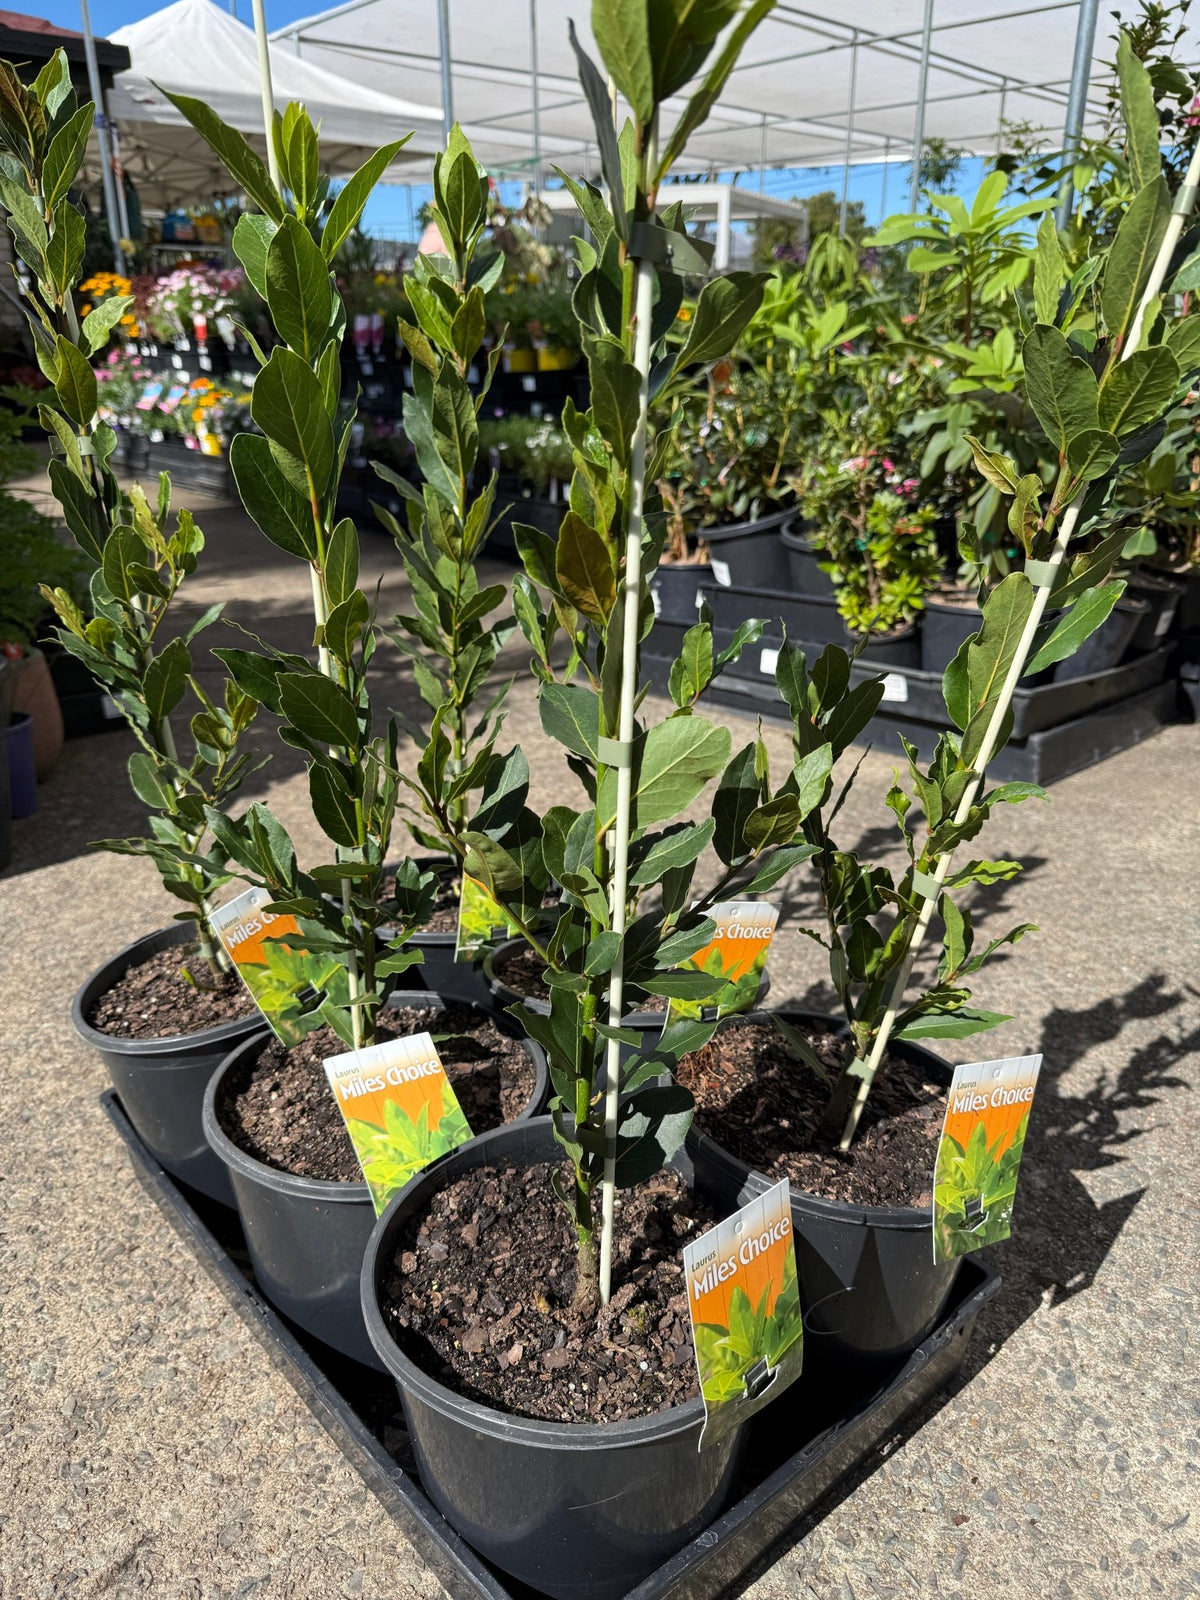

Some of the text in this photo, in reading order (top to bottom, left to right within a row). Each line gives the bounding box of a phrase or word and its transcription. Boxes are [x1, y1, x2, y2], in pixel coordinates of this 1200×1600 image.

[225, 918, 262, 949] Miles
[727, 923, 772, 939] Choice
[335, 1067, 360, 1079] Laurus
[339, 1060, 441, 1100] Miles Choice
[956, 1081, 977, 1090] Laurus
[952, 1084, 1034, 1114] Miles Choice
[691, 1250, 716, 1272] Laurus
[693, 1217, 790, 1300] Miles Choice
